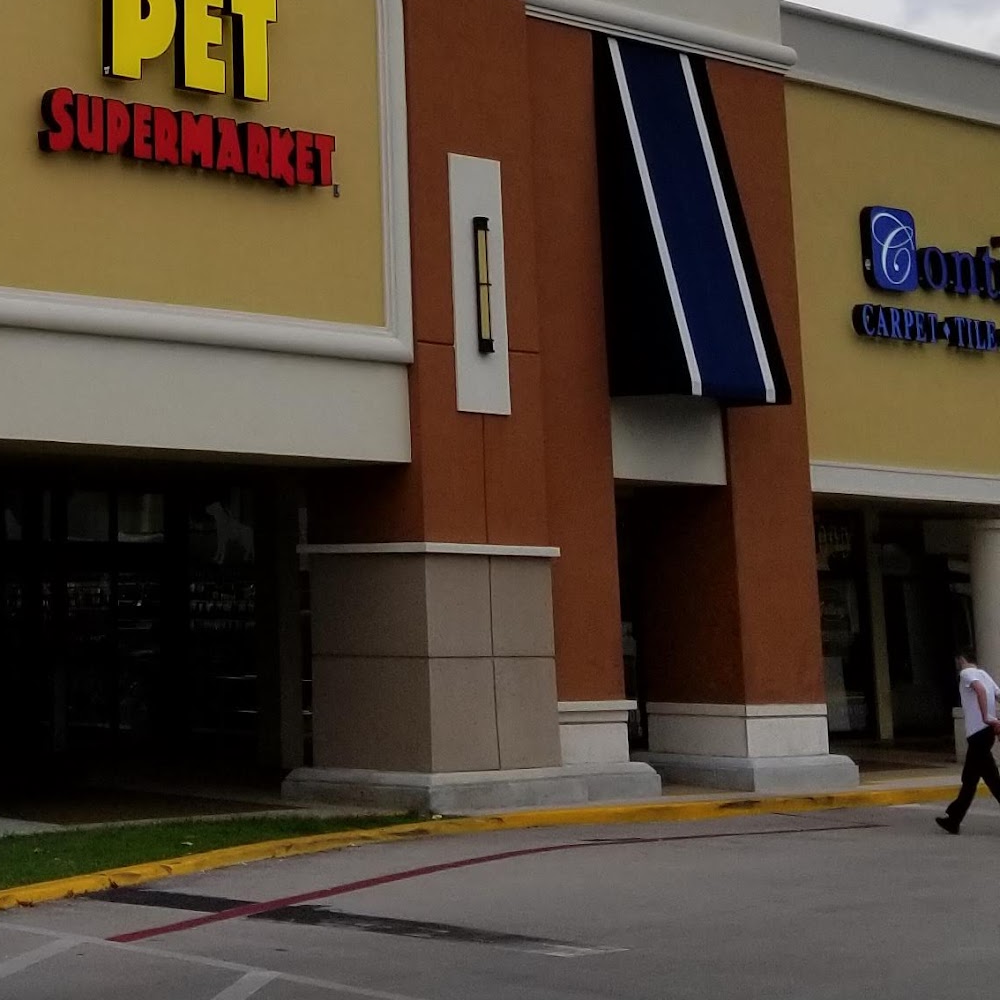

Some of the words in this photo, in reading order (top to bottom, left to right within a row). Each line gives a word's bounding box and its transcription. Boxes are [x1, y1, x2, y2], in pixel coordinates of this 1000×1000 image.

[39, 87, 335, 187] SUPERMARKET
[855, 303, 938, 343] CARPET
[951, 316, 998, 351] TILE
